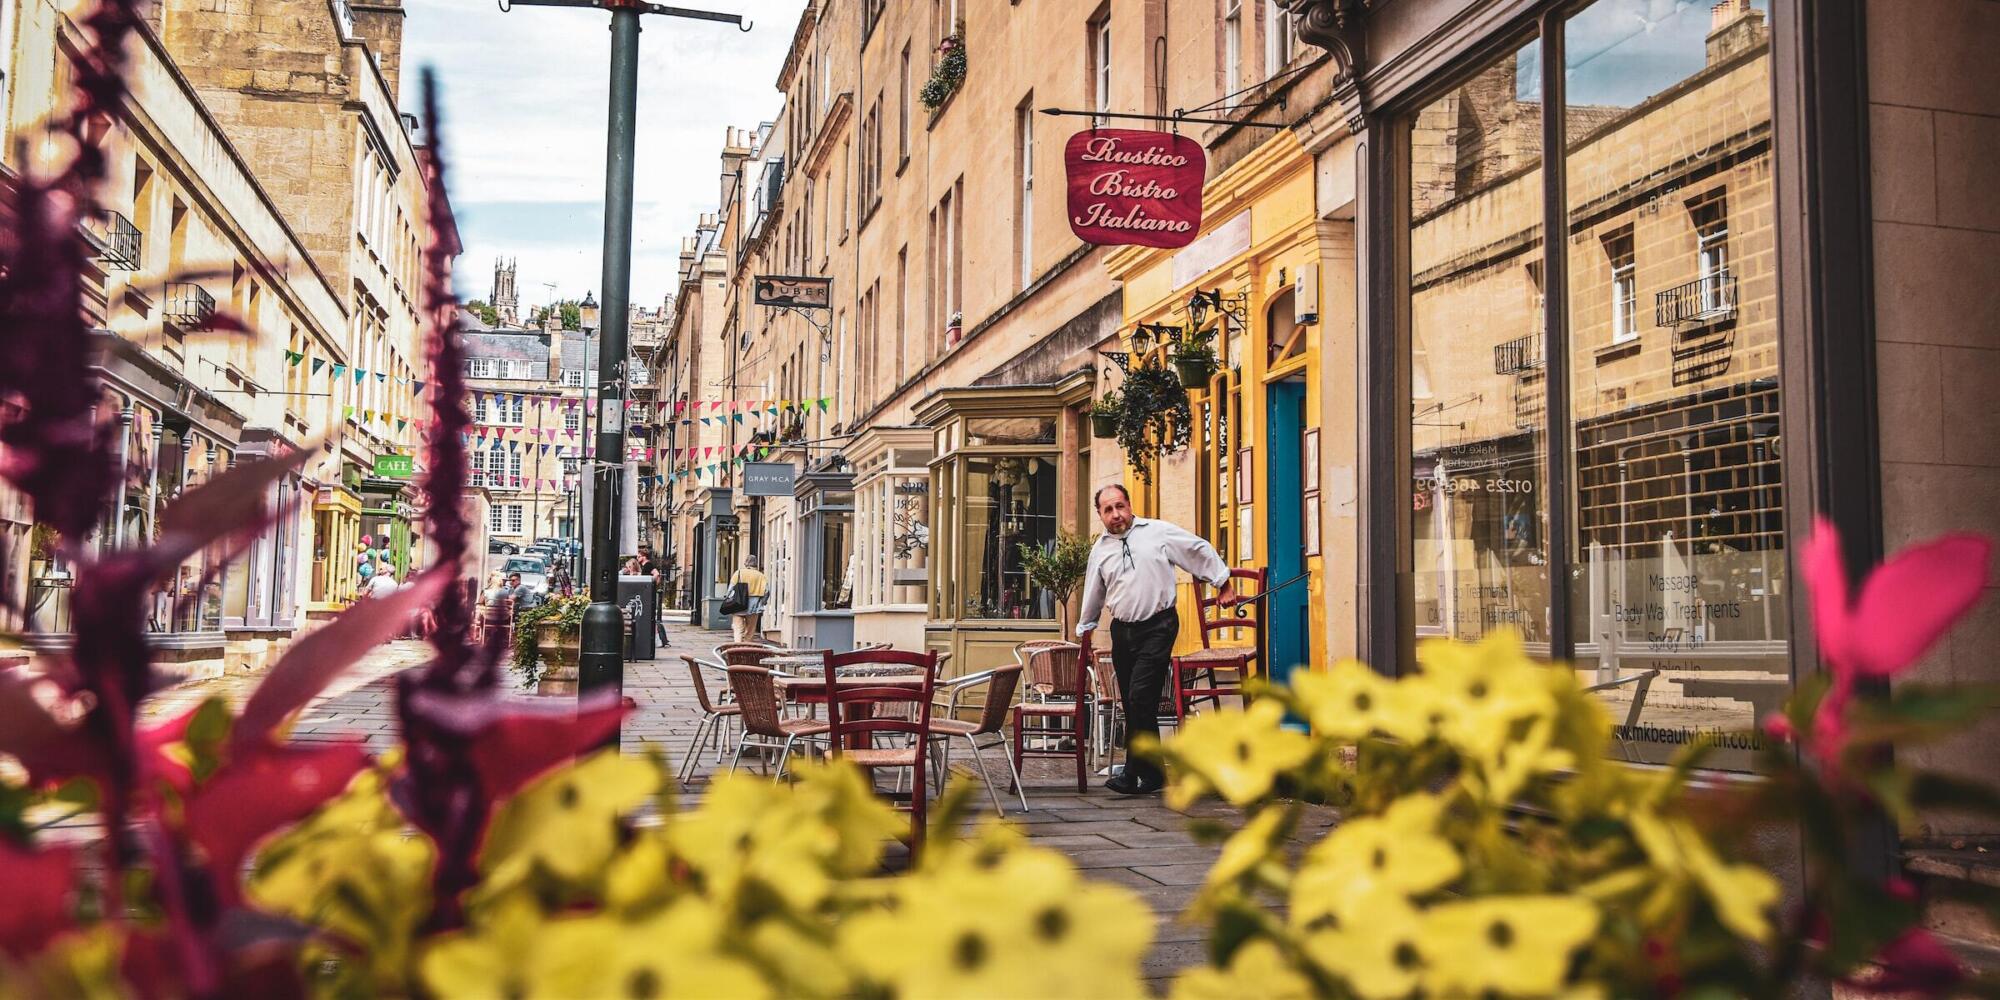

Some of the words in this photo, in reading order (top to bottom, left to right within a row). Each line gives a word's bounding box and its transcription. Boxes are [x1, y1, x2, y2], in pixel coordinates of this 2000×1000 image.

[1082, 137, 1187, 167] Rustico
[1629, 96, 1753, 190] BEAUTY
[1090, 169, 1178, 199] Bistro
[1075, 203, 1191, 232] Italiano
[780, 287, 825, 296] UBER
[1649, 573, 1698, 594] Massage
[1615, 603, 1643, 625] Body
[1646, 602, 1670, 622] Wax
[1672, 600, 1740, 620] Treatments
[1648, 630, 1680, 653] Spray
[1683, 630, 1705, 648] Tan
